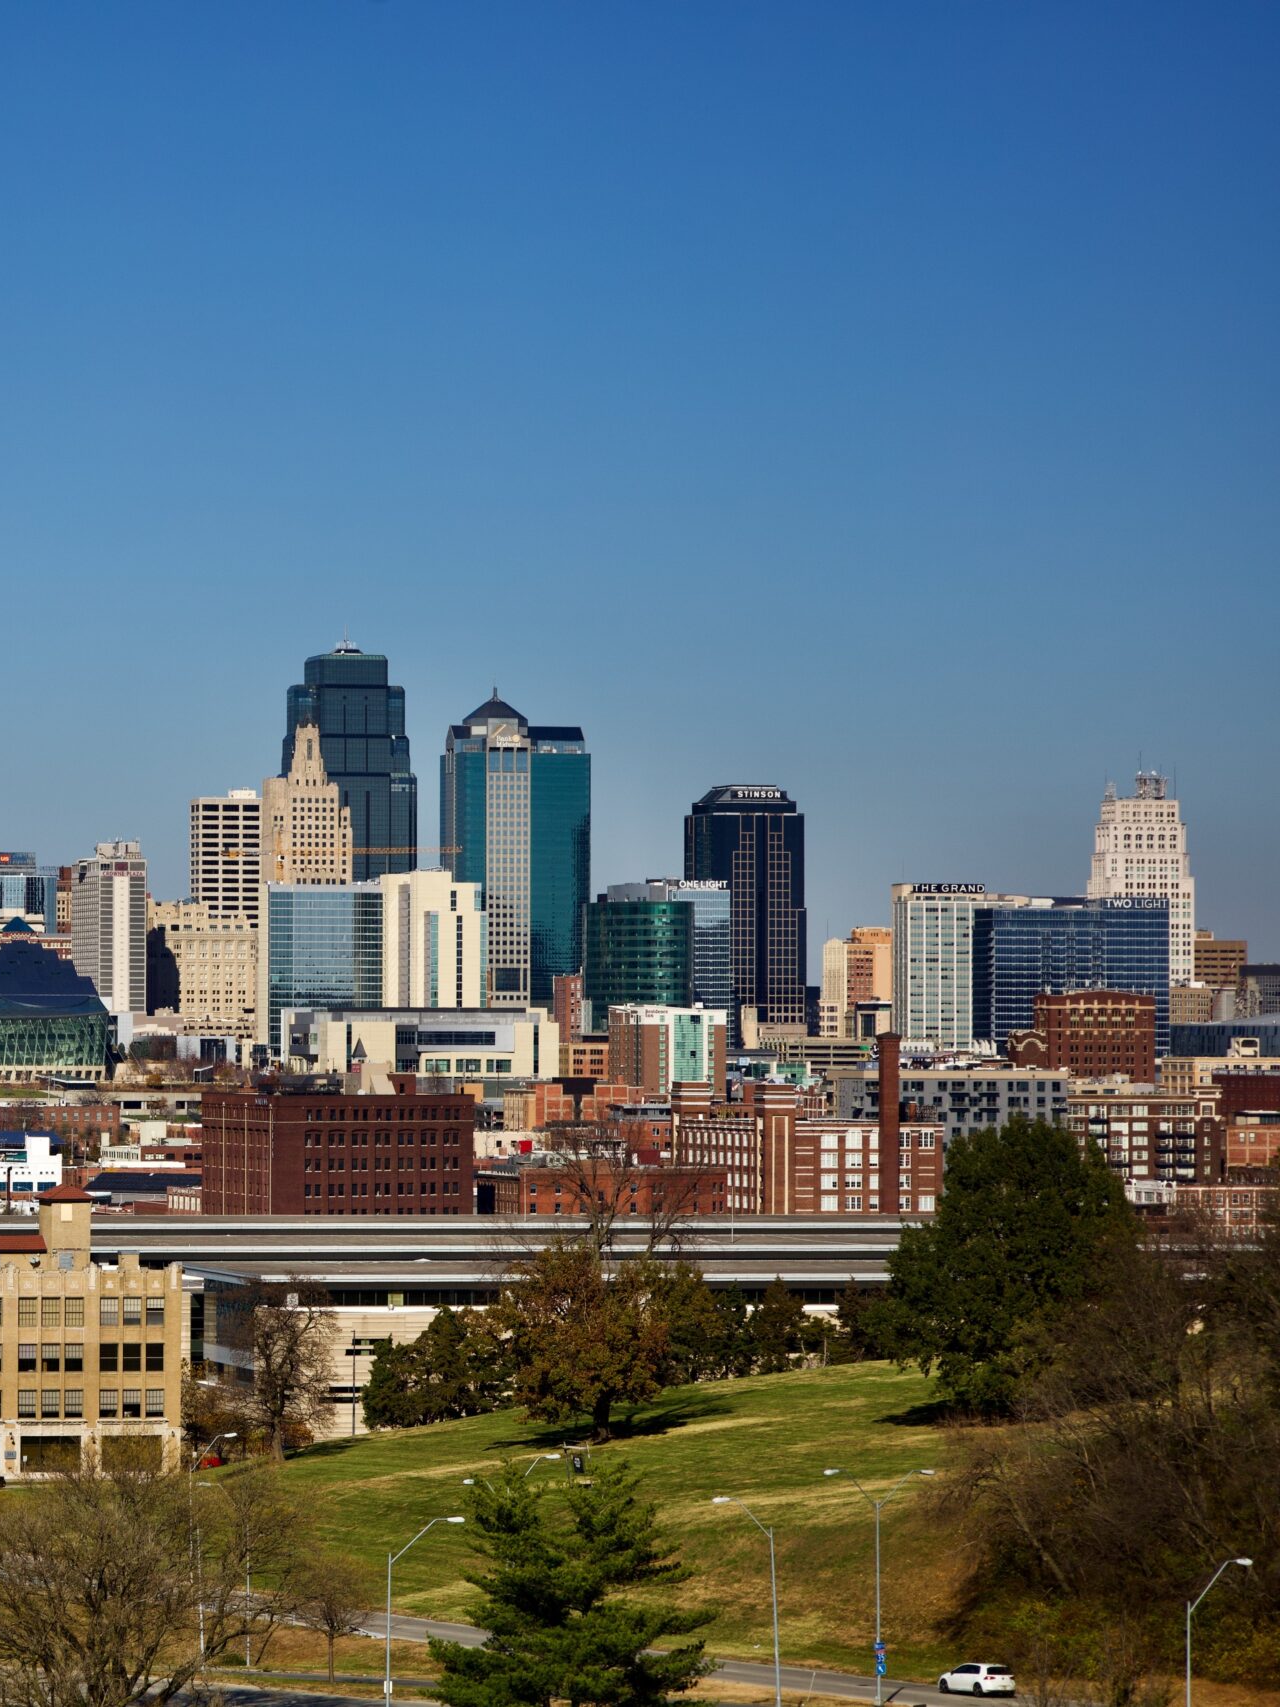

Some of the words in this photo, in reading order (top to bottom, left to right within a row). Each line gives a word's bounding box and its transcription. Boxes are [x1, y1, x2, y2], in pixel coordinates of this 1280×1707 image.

[737, 790, 781, 798] STINSON
[679, 880, 699, 888] ONE
[700, 880, 728, 889] LIGHT
[914, 884, 938, 893] THE
[941, 884, 985, 893] GRAND
[1105, 899, 1132, 908] TWO
[1135, 899, 1168, 909] LIGHT
[878, 1653, 885, 1662] 35
